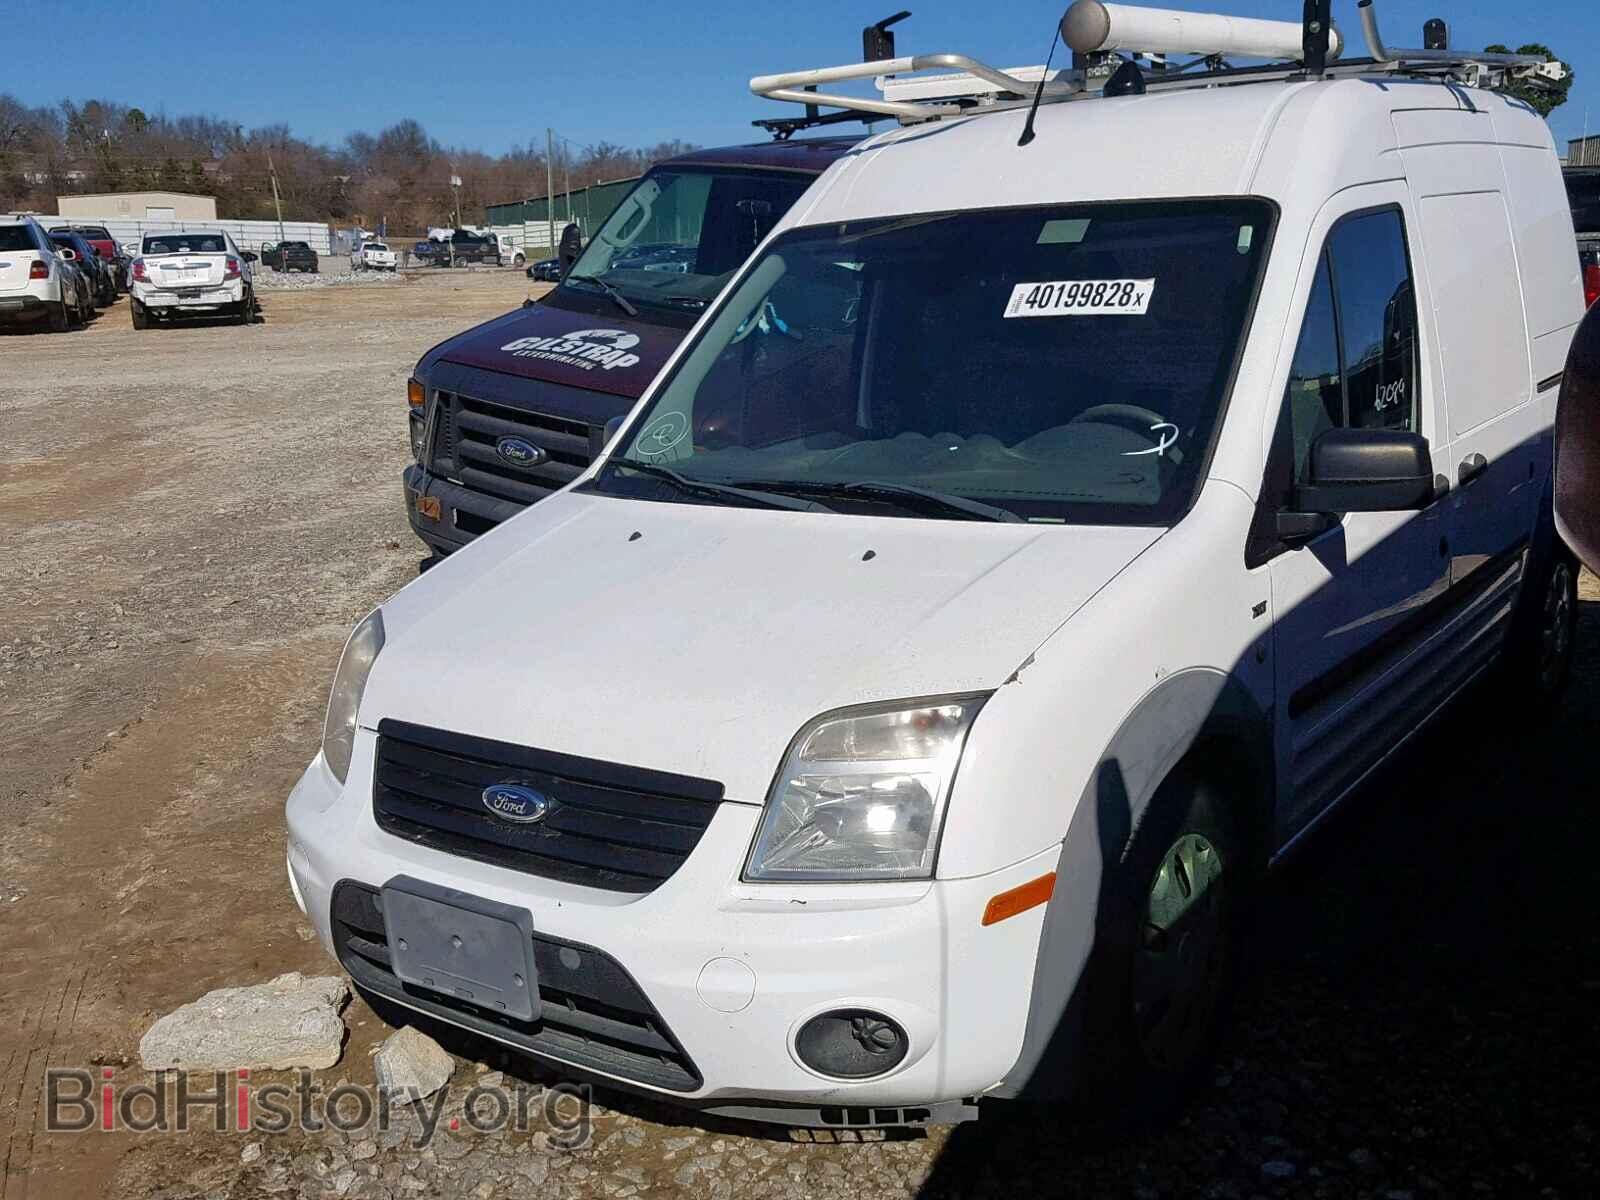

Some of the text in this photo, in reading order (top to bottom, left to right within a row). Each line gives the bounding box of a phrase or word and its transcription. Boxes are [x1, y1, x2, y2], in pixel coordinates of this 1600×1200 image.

[501, 336, 640, 370] GILSTRAP
[512, 349, 597, 370] EXTERMINATING
[494, 791, 526, 814] Ford
